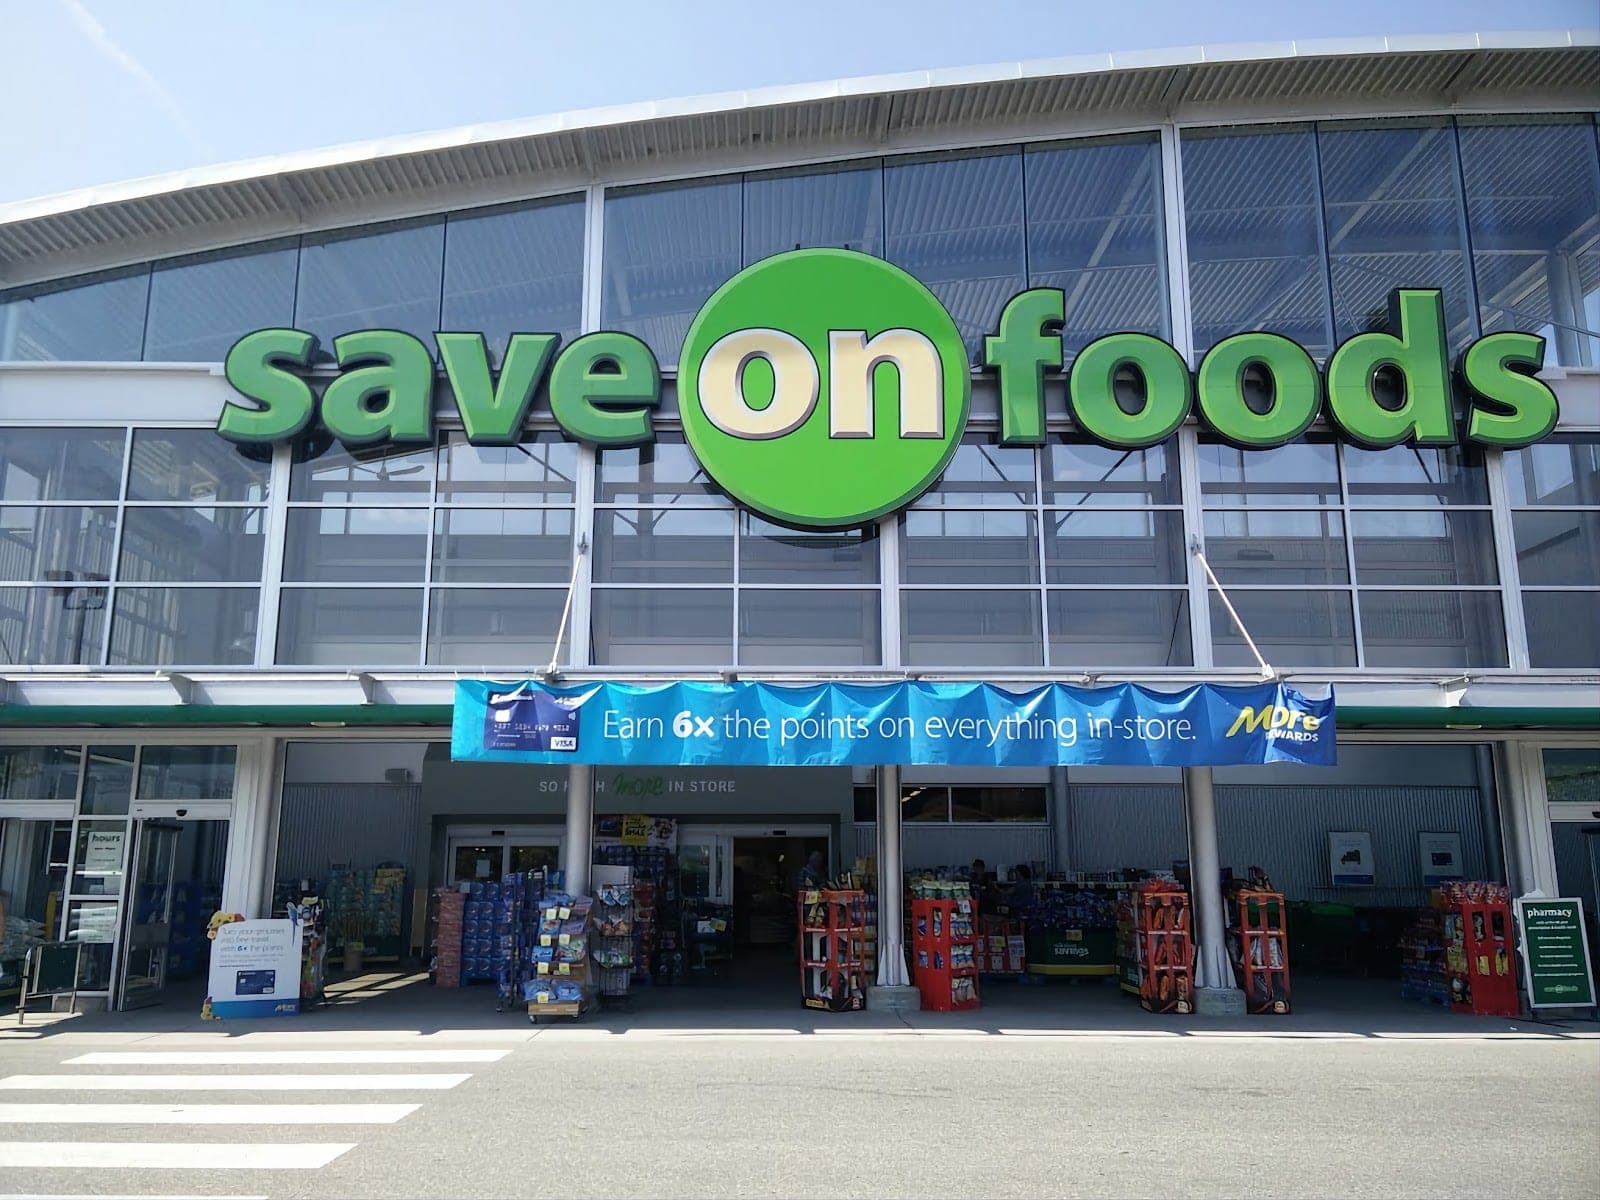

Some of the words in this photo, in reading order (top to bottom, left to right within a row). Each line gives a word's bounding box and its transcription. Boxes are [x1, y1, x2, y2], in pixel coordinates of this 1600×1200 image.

[217, 327, 661, 446] save
[698, 327, 945, 441] on
[982, 288, 1560, 450] foods
[603, 709, 664, 739] Earn
[672, 710, 715, 739] 6x
[722, 708, 771, 739] the
[780, 712, 870, 747] points
[879, 716, 915, 739] on
[925, 712, 1077, 747] everything
[1087, 711, 1197, 740] in-store.
[1225, 704, 1320, 738] More
[539, 781, 558, 793] SO
[668, 781, 684, 793] IN
[690, 781, 736, 793] STORE
[92, 833, 121, 842] hours
[1527, 908, 1573, 919] pharmacy
